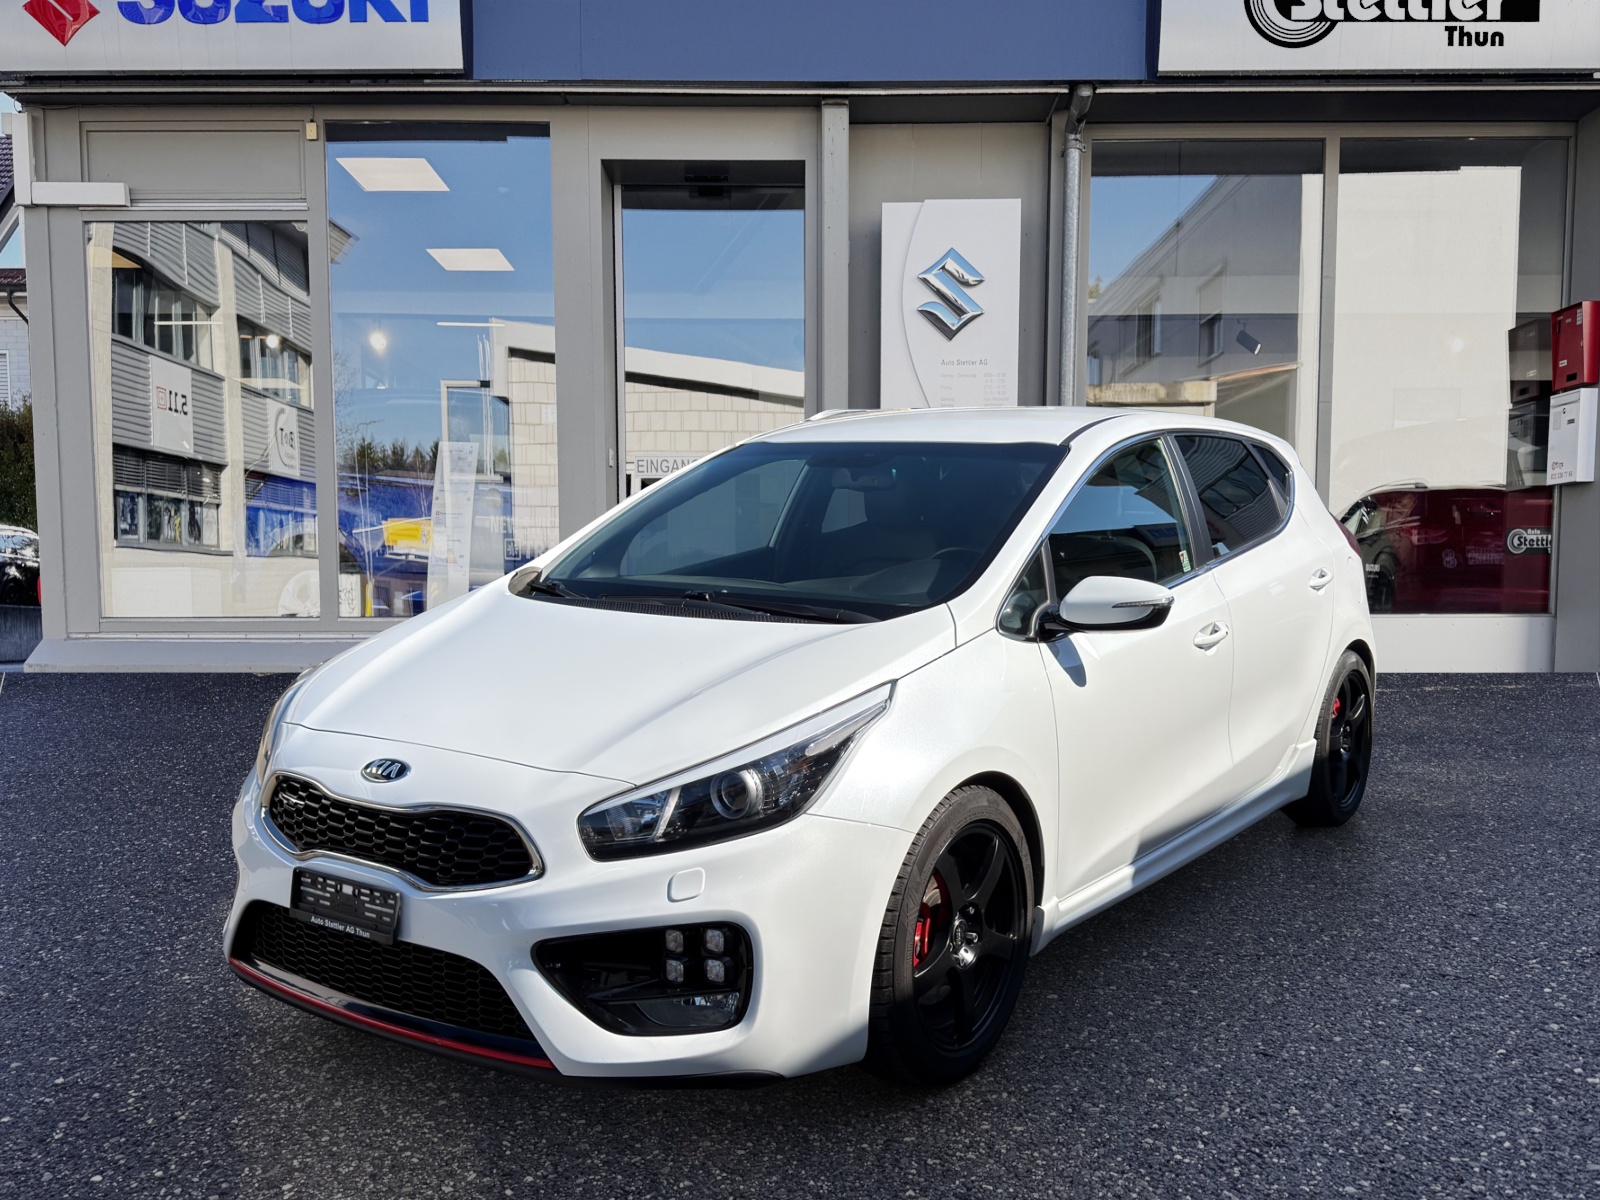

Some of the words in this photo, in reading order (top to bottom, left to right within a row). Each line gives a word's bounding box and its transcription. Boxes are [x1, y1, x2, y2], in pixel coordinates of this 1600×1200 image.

[1444, 25, 1505, 47] Thun
[637, 458, 700, 474] EINGAN
[1516, 535, 1552, 547] Stettl
[366, 759, 402, 779] KIA
[310, 915, 325, 926] Auto
[324, 919, 346, 932] Stettler
[345, 925, 355, 934] AG
[356, 927, 371, 939] Thun
